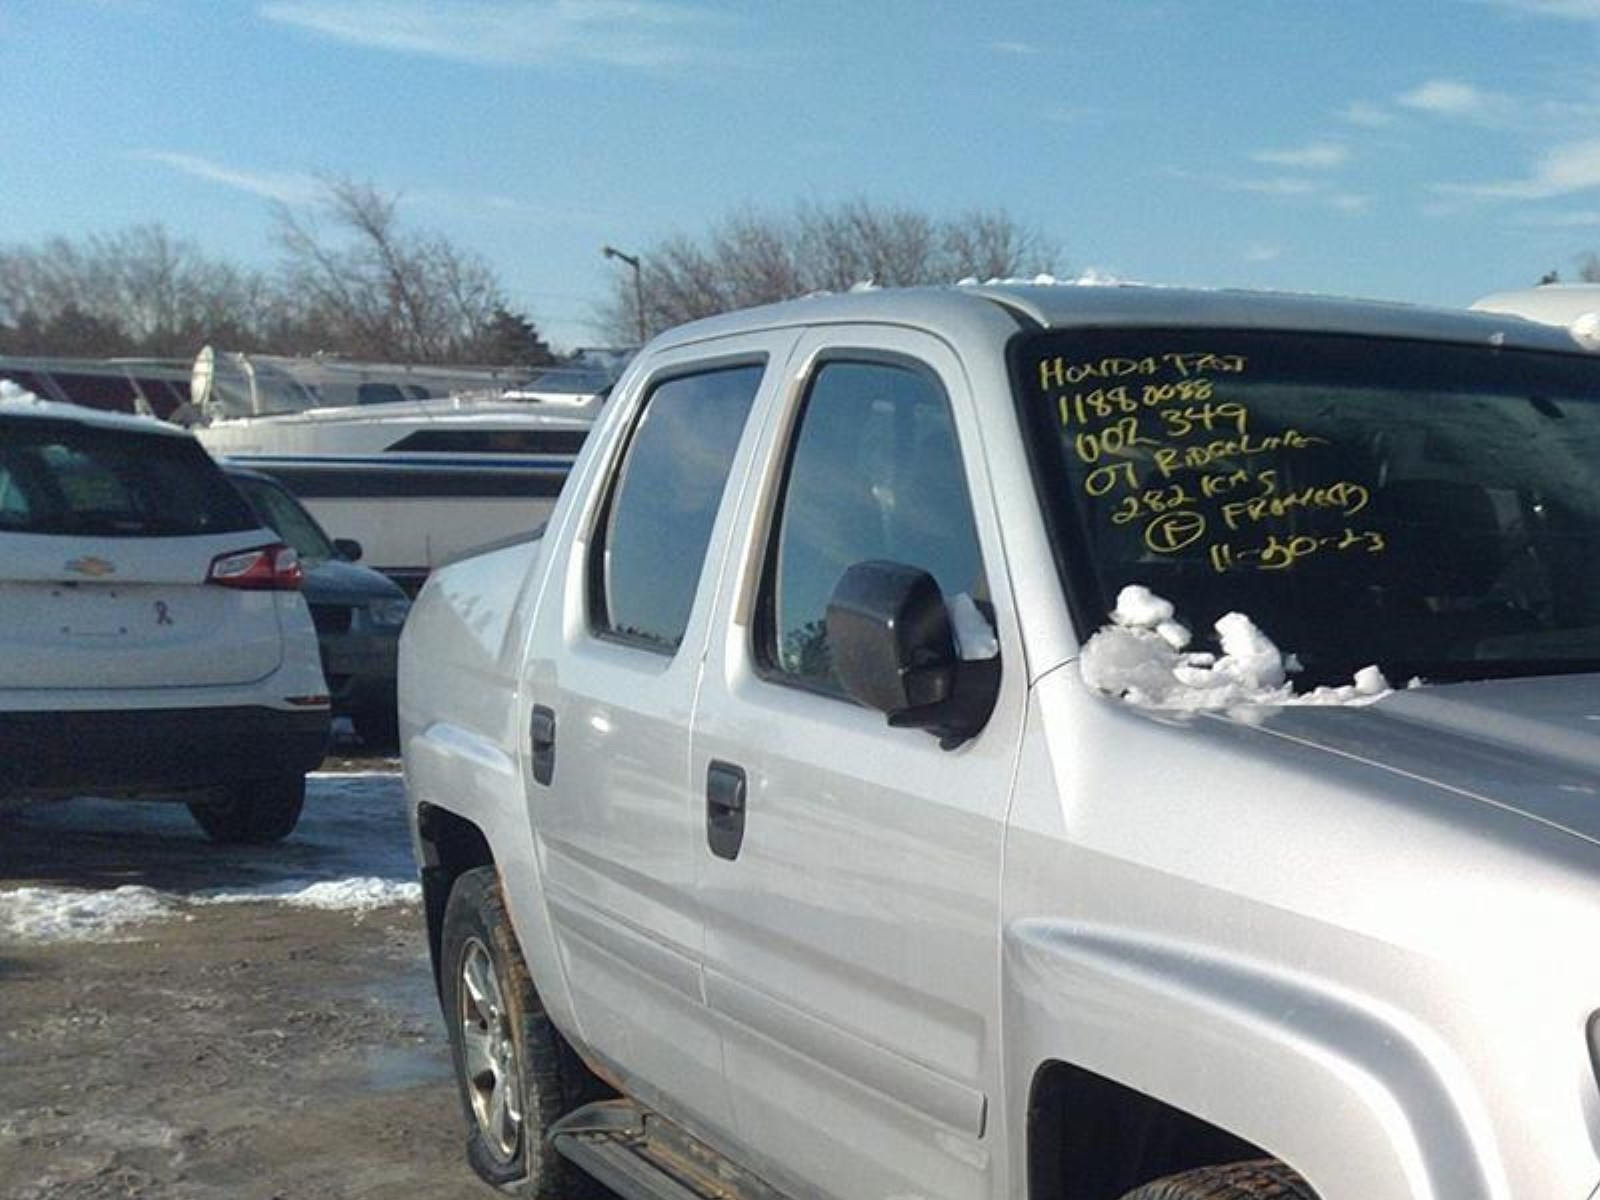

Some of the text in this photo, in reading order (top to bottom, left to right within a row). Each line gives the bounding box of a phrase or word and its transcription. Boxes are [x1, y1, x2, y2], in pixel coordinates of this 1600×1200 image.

[1038, 355, 1158, 391] HONDA
[1161, 402, 1248, 437] 349
[1110, 483, 1195, 524] 282
